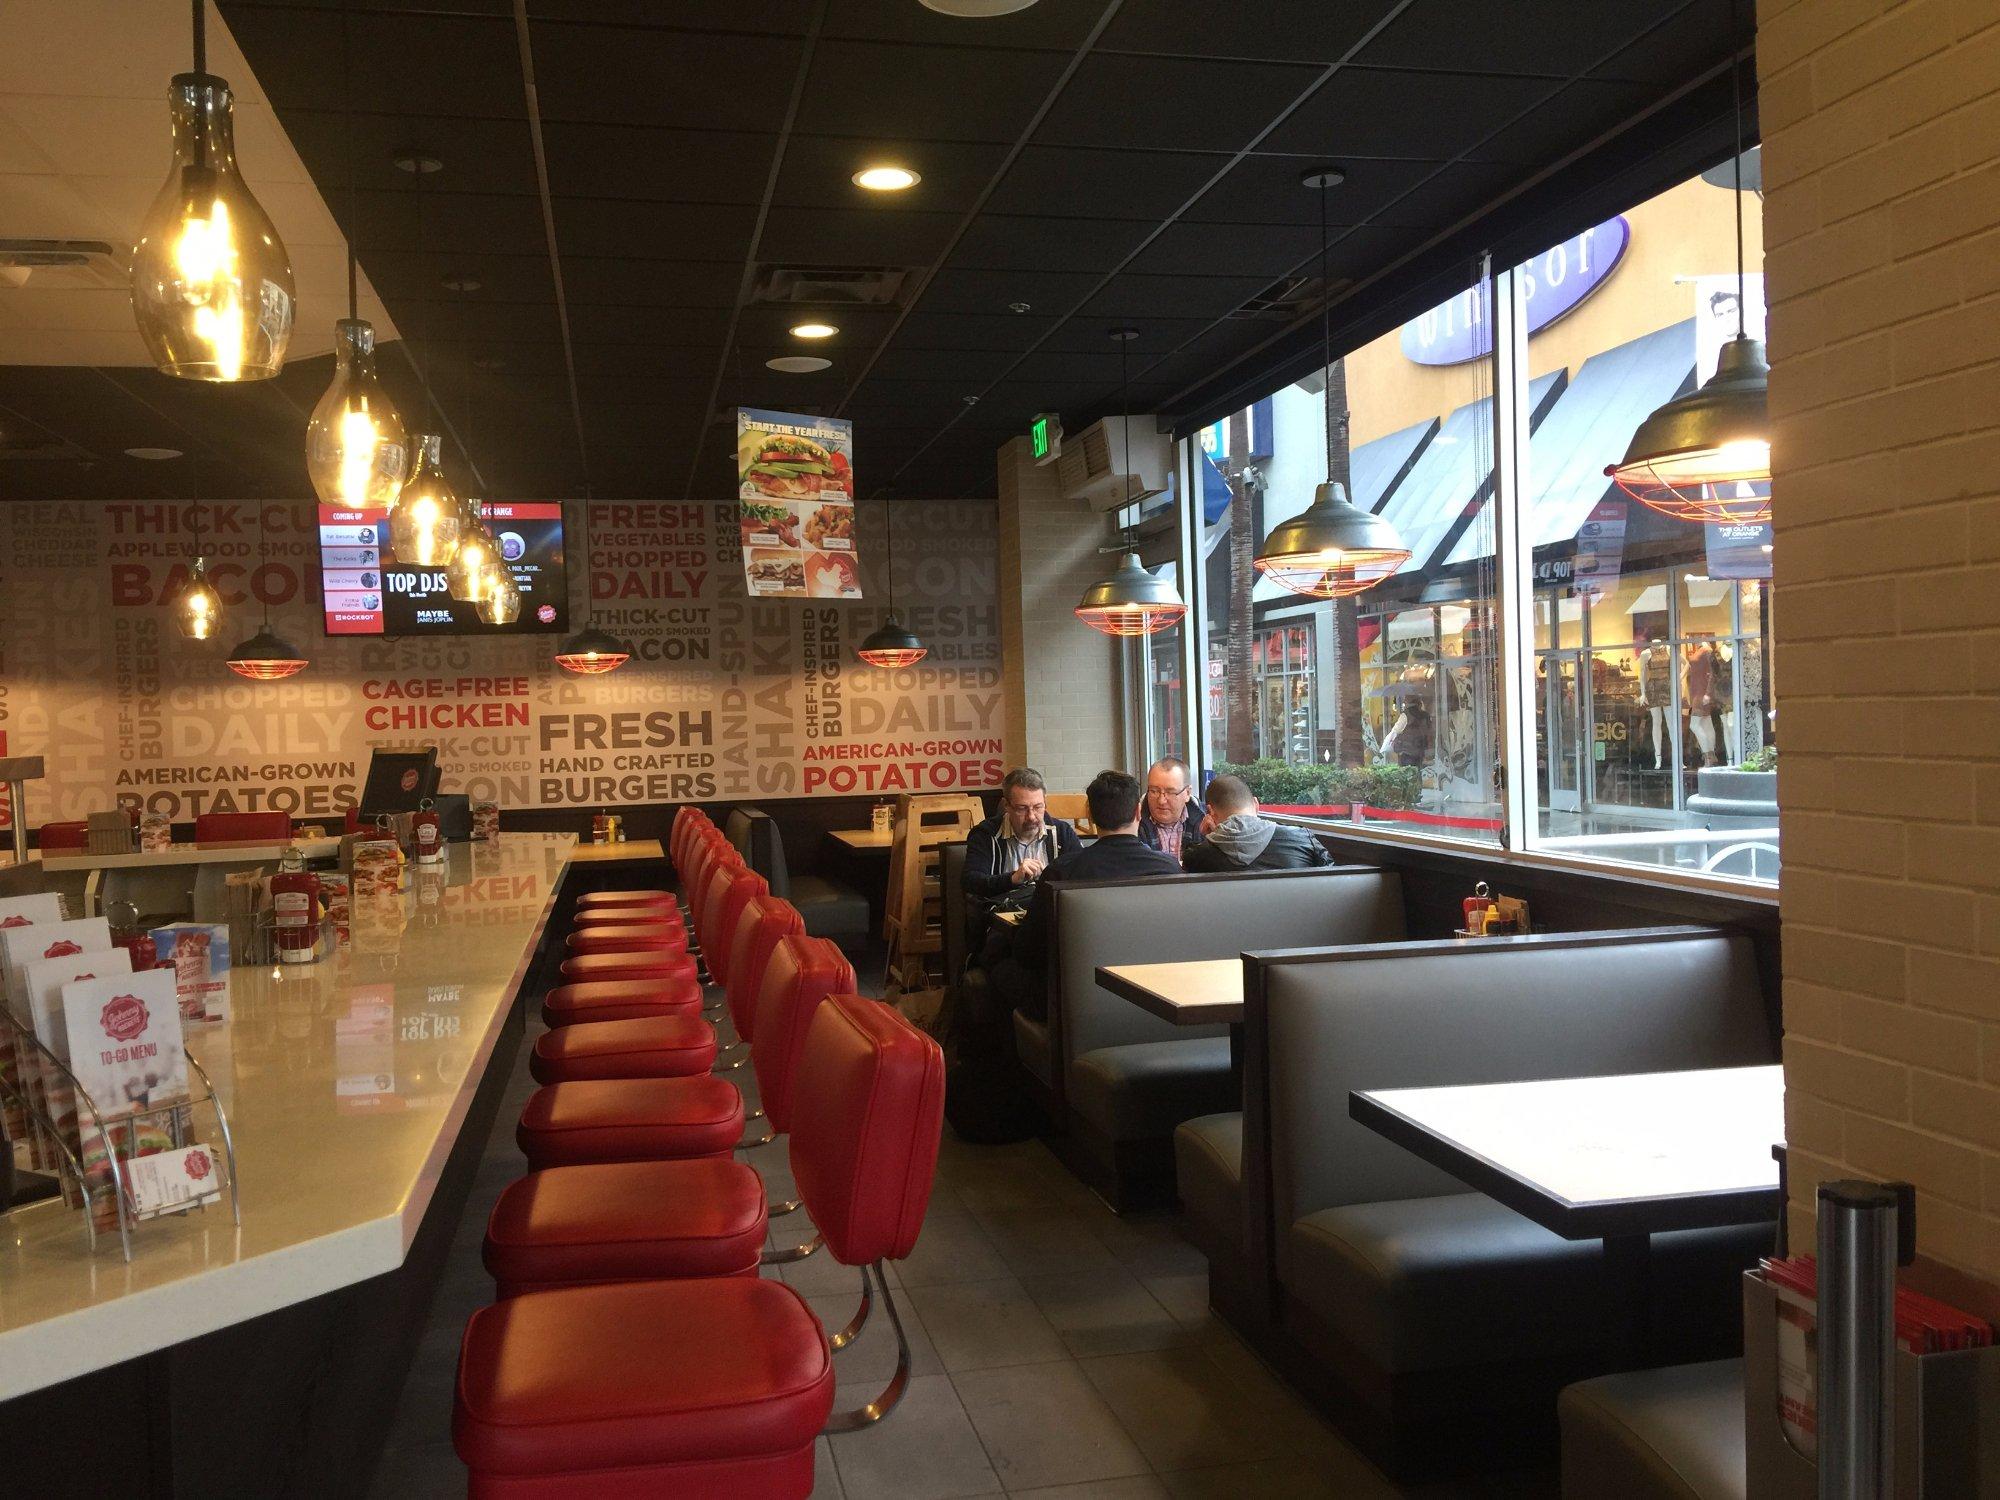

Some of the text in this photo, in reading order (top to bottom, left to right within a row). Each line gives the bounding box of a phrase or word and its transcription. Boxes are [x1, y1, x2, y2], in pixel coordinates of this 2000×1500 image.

[745, 420, 776, 433] START
[777, 424, 794, 435] THE
[795, 426, 818, 438] YEAR
[1032, 418, 1048, 458] EXIT
[11, 504, 96, 524] REAL
[104, 505, 318, 534] THICK-CU
[588, 504, 705, 528] FRESH
[106, 542, 318, 557] APPLEWOOD SMOK
[590, 533, 706, 546] VEGETABLES
[590, 551, 708, 568] CHOPPED
[386, 573, 448, 593] TOP DJS
[591, 571, 708, 600] DAILY
[417, 610, 450, 618] MAYBE
[591, 608, 711, 625] THICK-CUT
[600, 627, 711, 637] PPLEWOOD SMOKED
[717, 573, 749, 794] HAND-SPUN
[802, 608, 819, 738] CHEF-INSPIRED
[819, 607, 843, 737] BURGERS
[850, 667, 999, 693] CHOPPED
[135, 617, 163, 761] BURGERS
[169, 682, 351, 711] CHOPPED
[361, 676, 530, 700] CAGE-FREE
[594, 685, 714, 704] BURGERS
[752, 603, 796, 794] SHAKE
[364, 702, 530, 731] CHICKEN
[850, 693, 1003, 735] DAILY
[170, 712, 355, 758] DAILY
[539, 711, 713, 752] FRESH
[1594, 721, 1627, 741] BIG
[803, 739, 1003, 760] AMERICAN-GROWN
[115, 761, 356, 786] AMERICAN-GROWN
[469, 760, 532, 773] SMOKED
[539, 752, 715, 774] HAND CRAFTED
[539, 772, 717, 804] BURGERS
[803, 759, 1005, 794] POTATOES
[116, 784, 358, 820] POTATOES
[100, 1042, 158, 1066] TO-GO MENU
